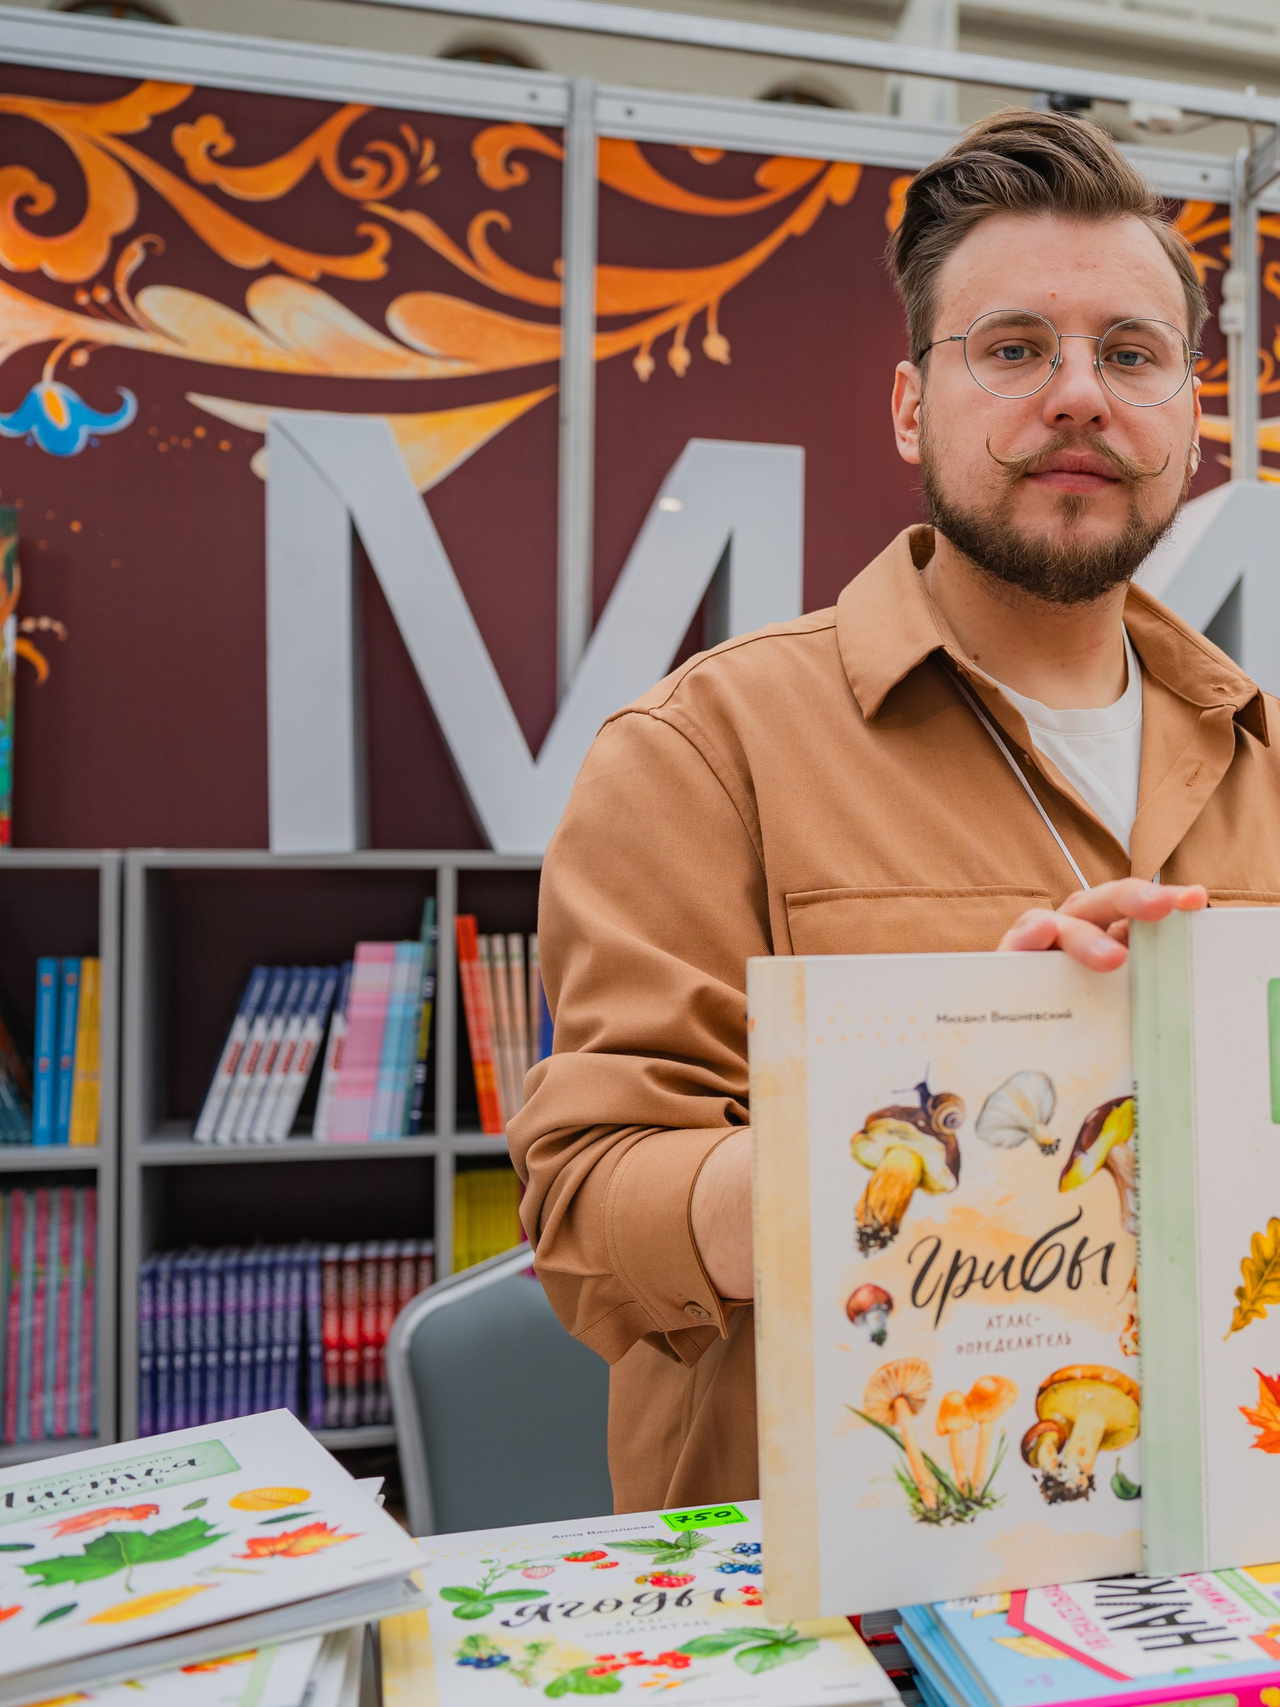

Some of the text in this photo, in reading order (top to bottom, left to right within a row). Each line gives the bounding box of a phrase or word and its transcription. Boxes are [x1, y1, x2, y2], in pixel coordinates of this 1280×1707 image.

[936, 1009, 1073, 1024] Михаил Вишневский
[674, 1510, 732, 1524] 750
[551, 1525, 655, 1540] Анна Васильева
